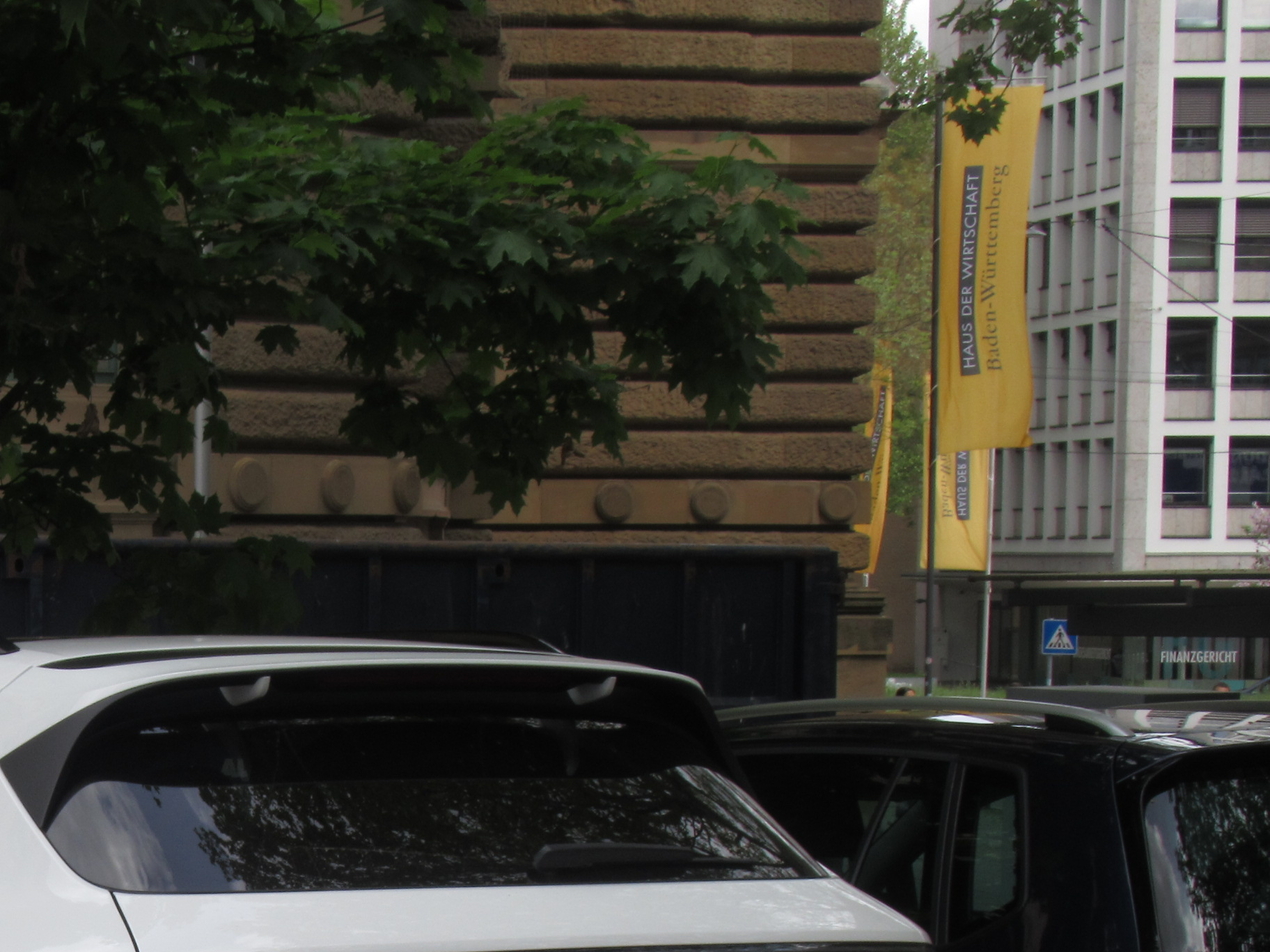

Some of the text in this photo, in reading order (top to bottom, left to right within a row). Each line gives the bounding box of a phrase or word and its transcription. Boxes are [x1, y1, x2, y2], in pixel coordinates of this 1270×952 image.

[961, 174, 979, 369] HAUS DER WIRTSCHAFT
[981, 165, 1010, 370] Baden-Württemberg
[1160, 650, 1238, 664] FINANZGERICHT
